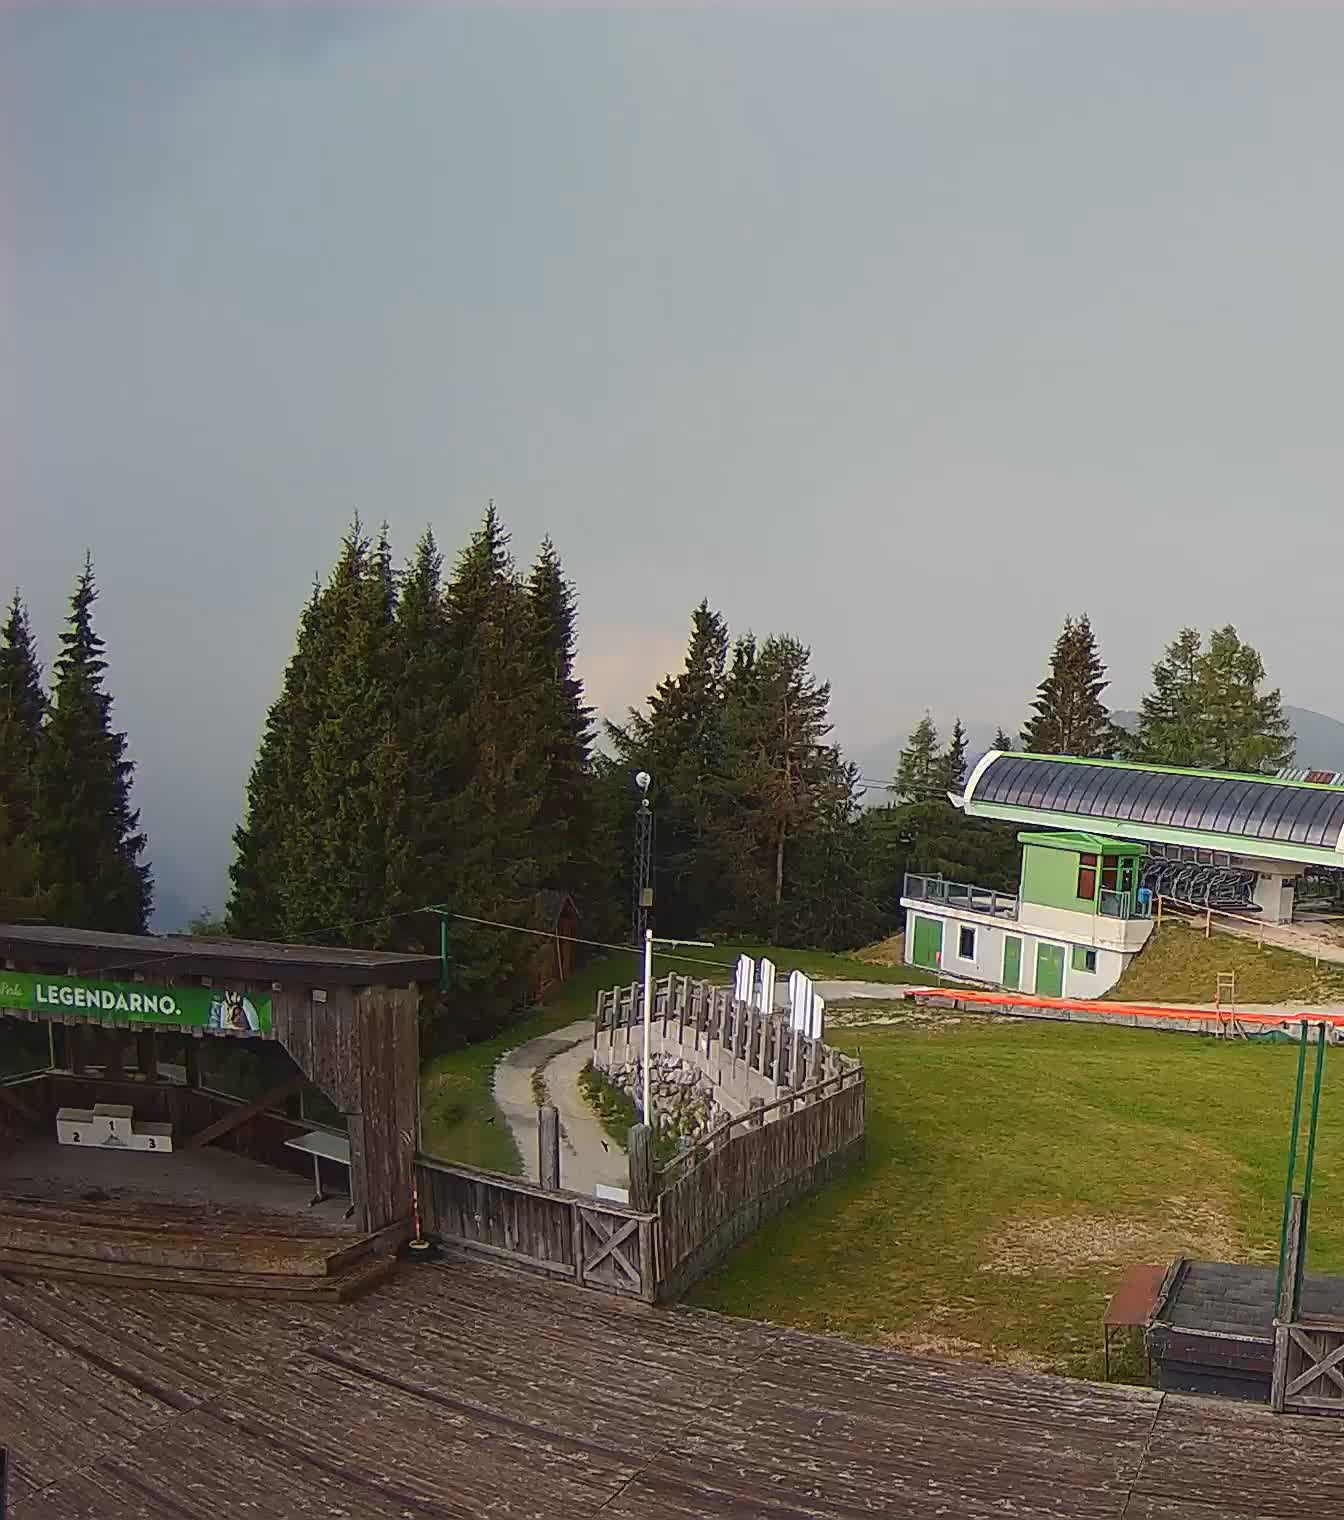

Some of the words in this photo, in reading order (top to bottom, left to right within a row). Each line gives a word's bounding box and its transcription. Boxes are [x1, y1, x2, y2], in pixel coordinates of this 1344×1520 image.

[36, 983, 182, 1016] LEGENDARNO.
[72, 1131, 81, 1143] 2
[148, 1138, 157, 1149] 3
